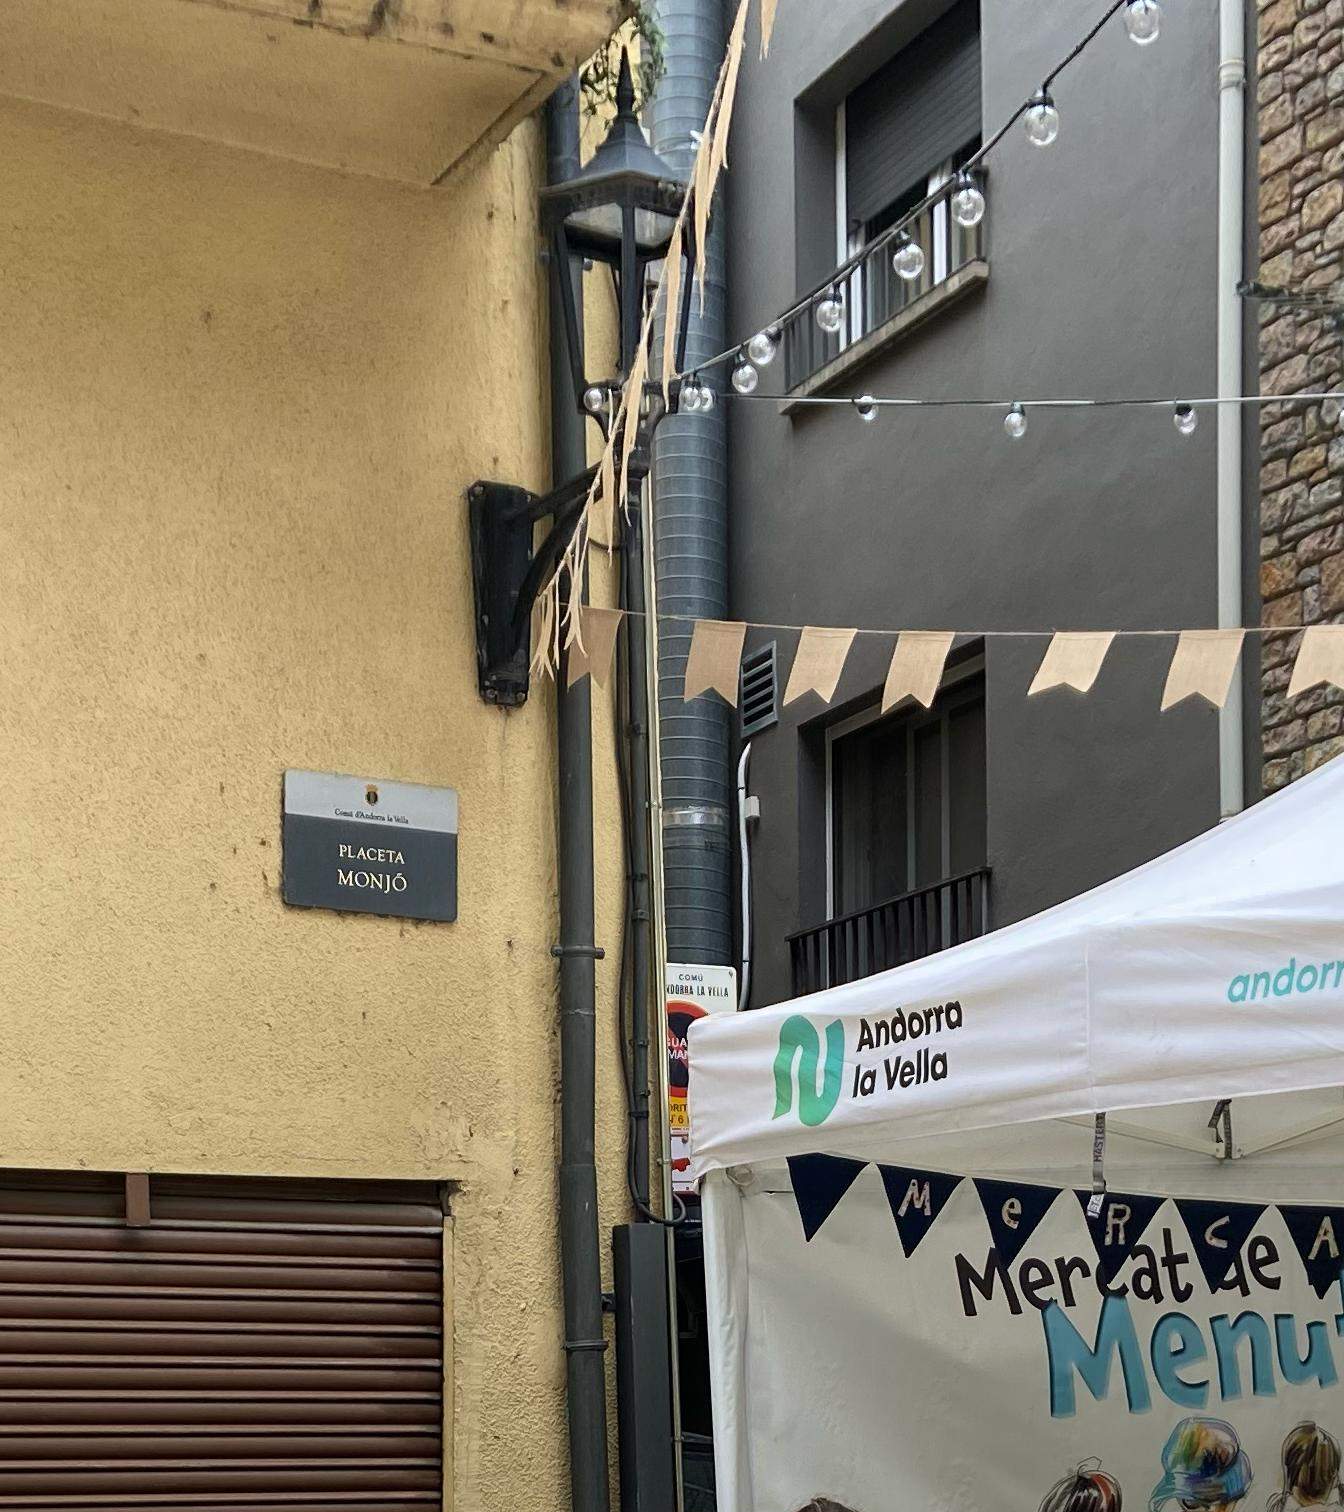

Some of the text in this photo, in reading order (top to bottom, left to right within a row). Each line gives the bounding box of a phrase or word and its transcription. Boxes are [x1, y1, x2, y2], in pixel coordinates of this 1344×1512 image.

[338, 844, 406, 865] PLACETA
[337, 869, 408, 893] MONJÓ
[697, 986, 706, 996] LA
[708, 986, 729, 998] VELLA
[856, 1000, 963, 1052] Andorra
[853, 1048, 948, 1098] la Vella
